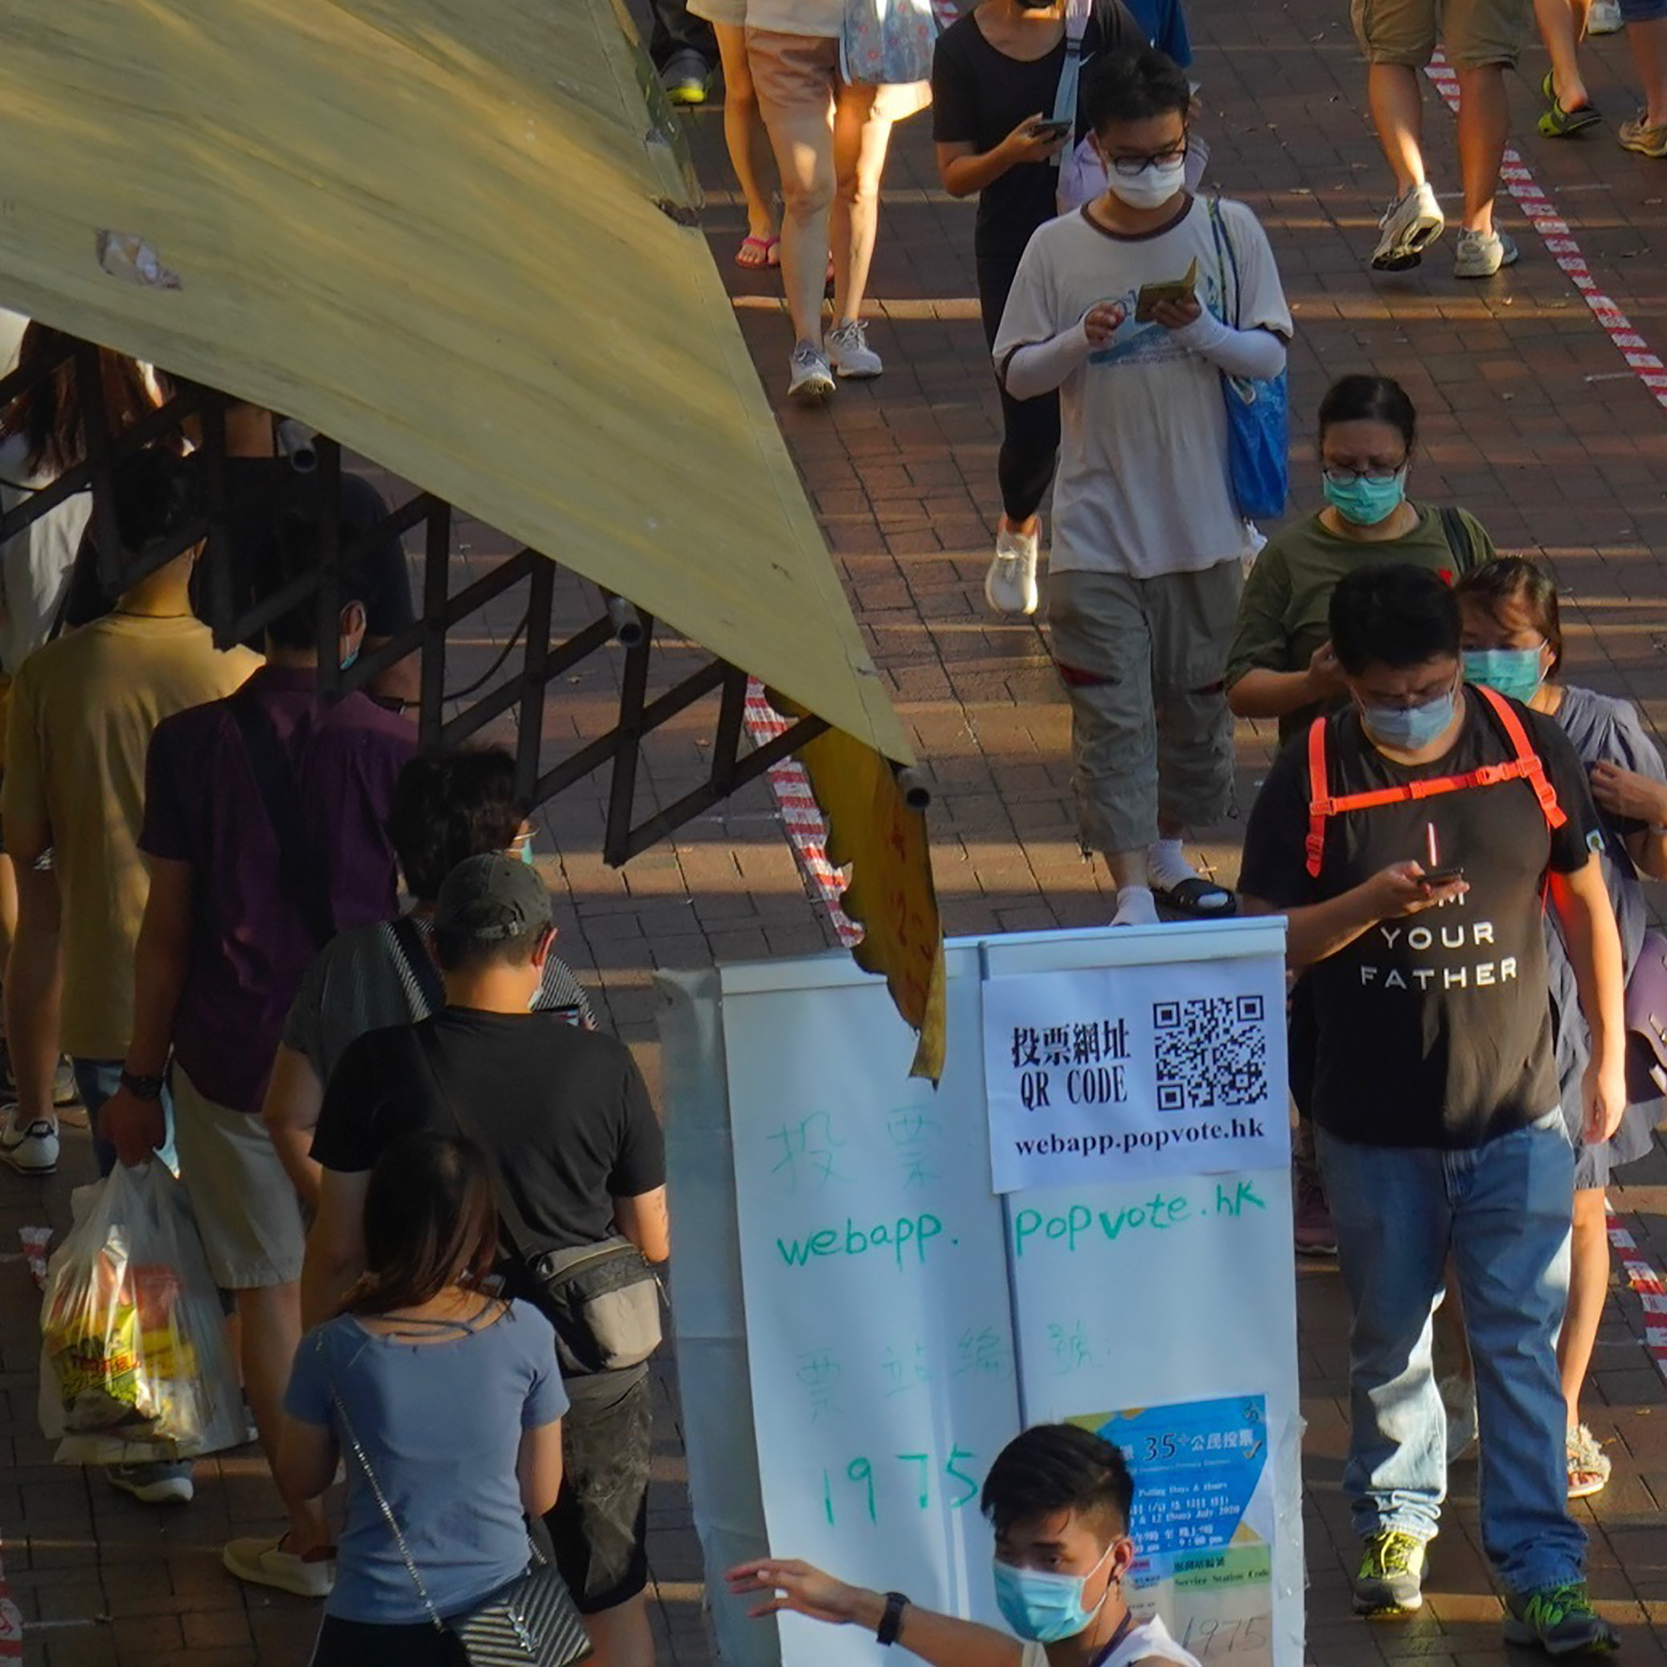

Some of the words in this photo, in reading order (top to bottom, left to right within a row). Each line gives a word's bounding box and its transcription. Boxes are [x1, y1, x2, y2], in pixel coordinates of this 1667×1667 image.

[1380, 920, 1496, 951] YOUR
[1360, 955, 1518, 991] FATHER
[1011, 1018, 1132, 1068] 投票網址
[1020, 1069, 1052, 1111] QR
[1066, 1065, 1129, 1107] CODE
[1014, 1117, 1266, 1158] webapp.popvote.hk
[777, 1212, 960, 1272] webapp.
[1015, 1179, 1267, 1258] popvote.hk
[822, 1444, 978, 1526] 1975
[1213, 1573, 1244, 1583] Station
